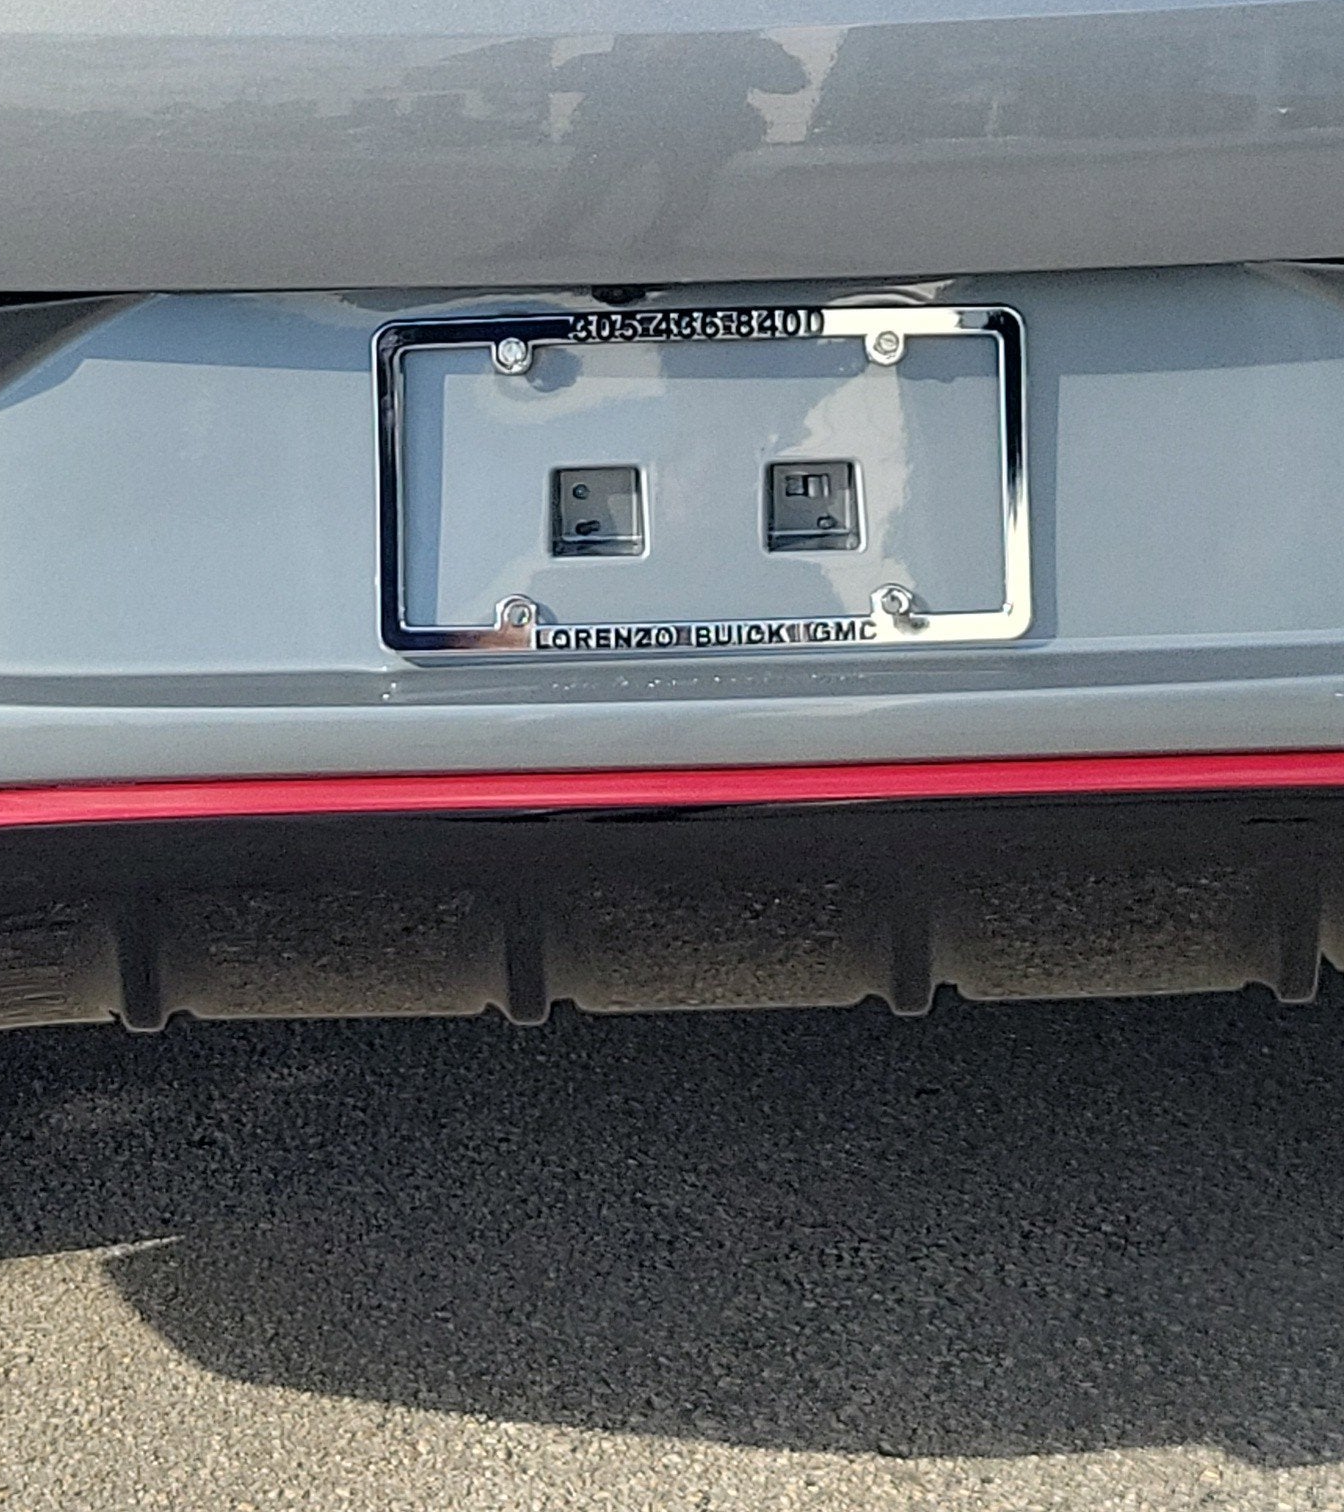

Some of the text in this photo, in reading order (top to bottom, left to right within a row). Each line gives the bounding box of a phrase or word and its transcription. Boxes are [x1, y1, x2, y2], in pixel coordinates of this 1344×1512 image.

[534, 619, 878, 650] LORENZO BUICK GMC
